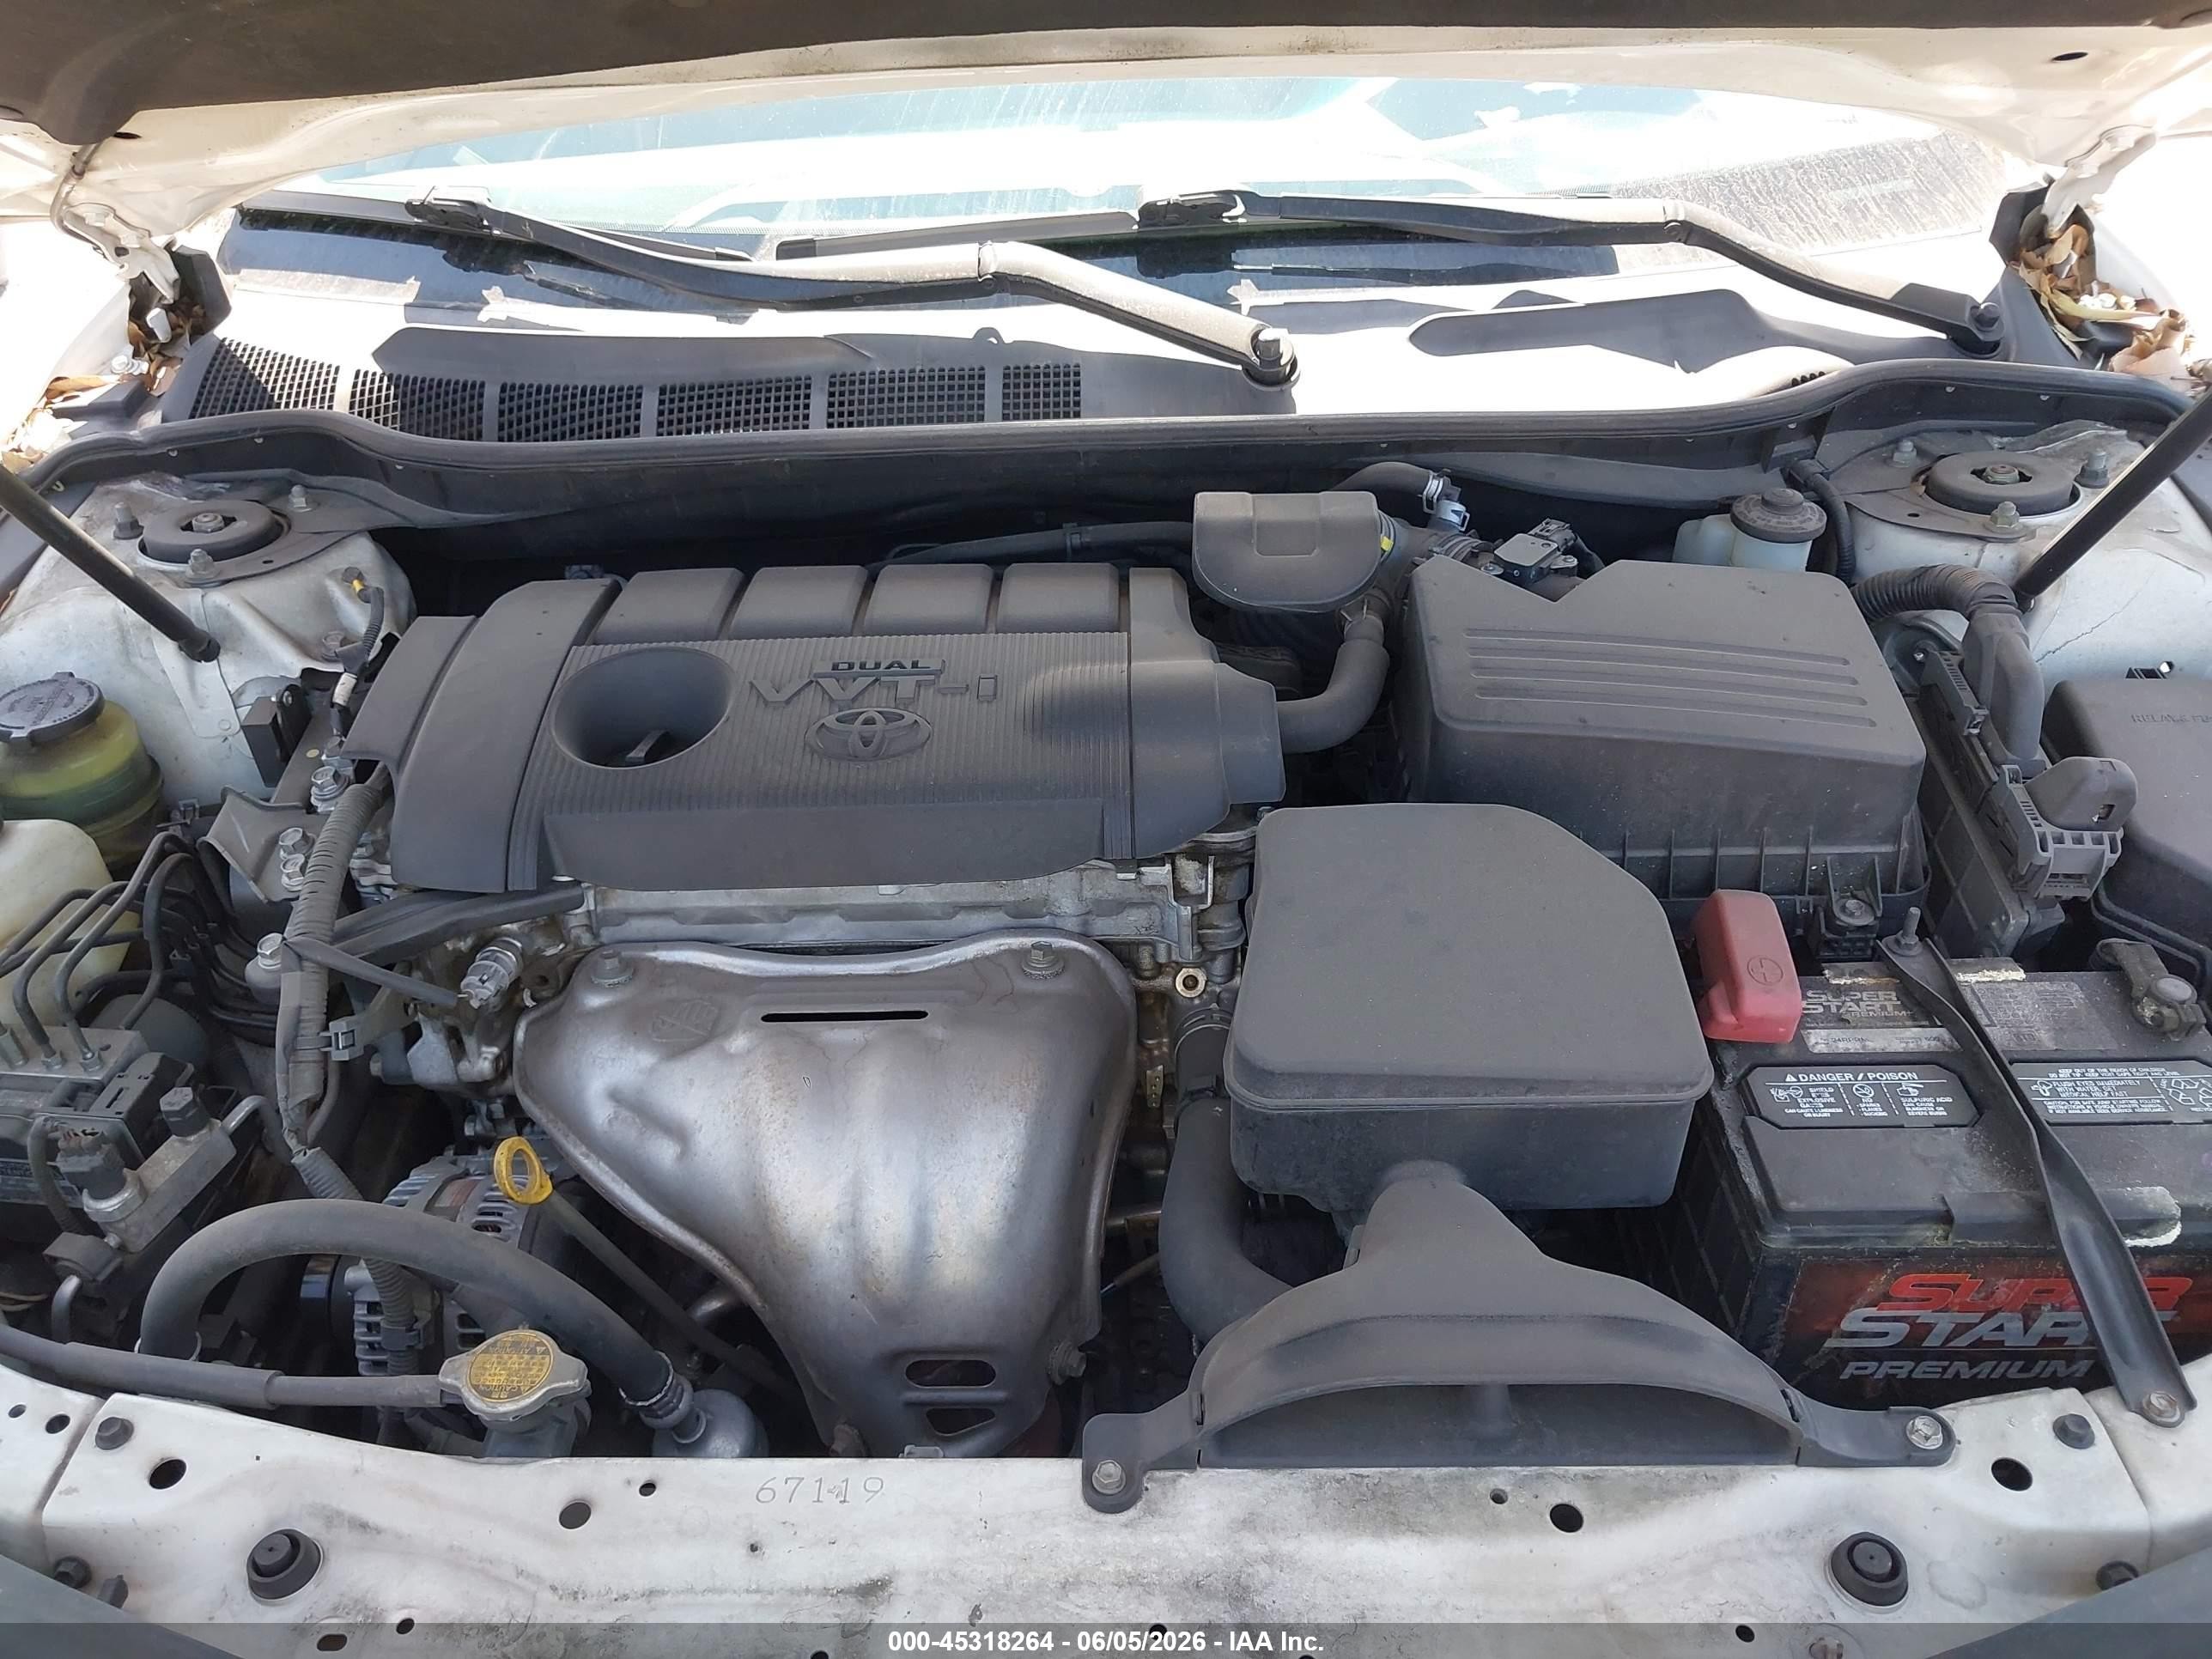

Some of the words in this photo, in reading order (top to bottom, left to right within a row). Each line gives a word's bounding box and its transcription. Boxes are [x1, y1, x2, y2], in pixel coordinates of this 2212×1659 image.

[830, 659, 931, 672] DUAL
[1806, 989, 1898, 1002] SUPER
[1801, 1000, 1902, 1014] START
[1798, 1073, 1855, 1083] DANGER
[1866, 1072, 1919, 1081] POISON
[1876, 1273, 2193, 1312] SUPR
[1839, 1359, 2097, 1380] PREMIUM
